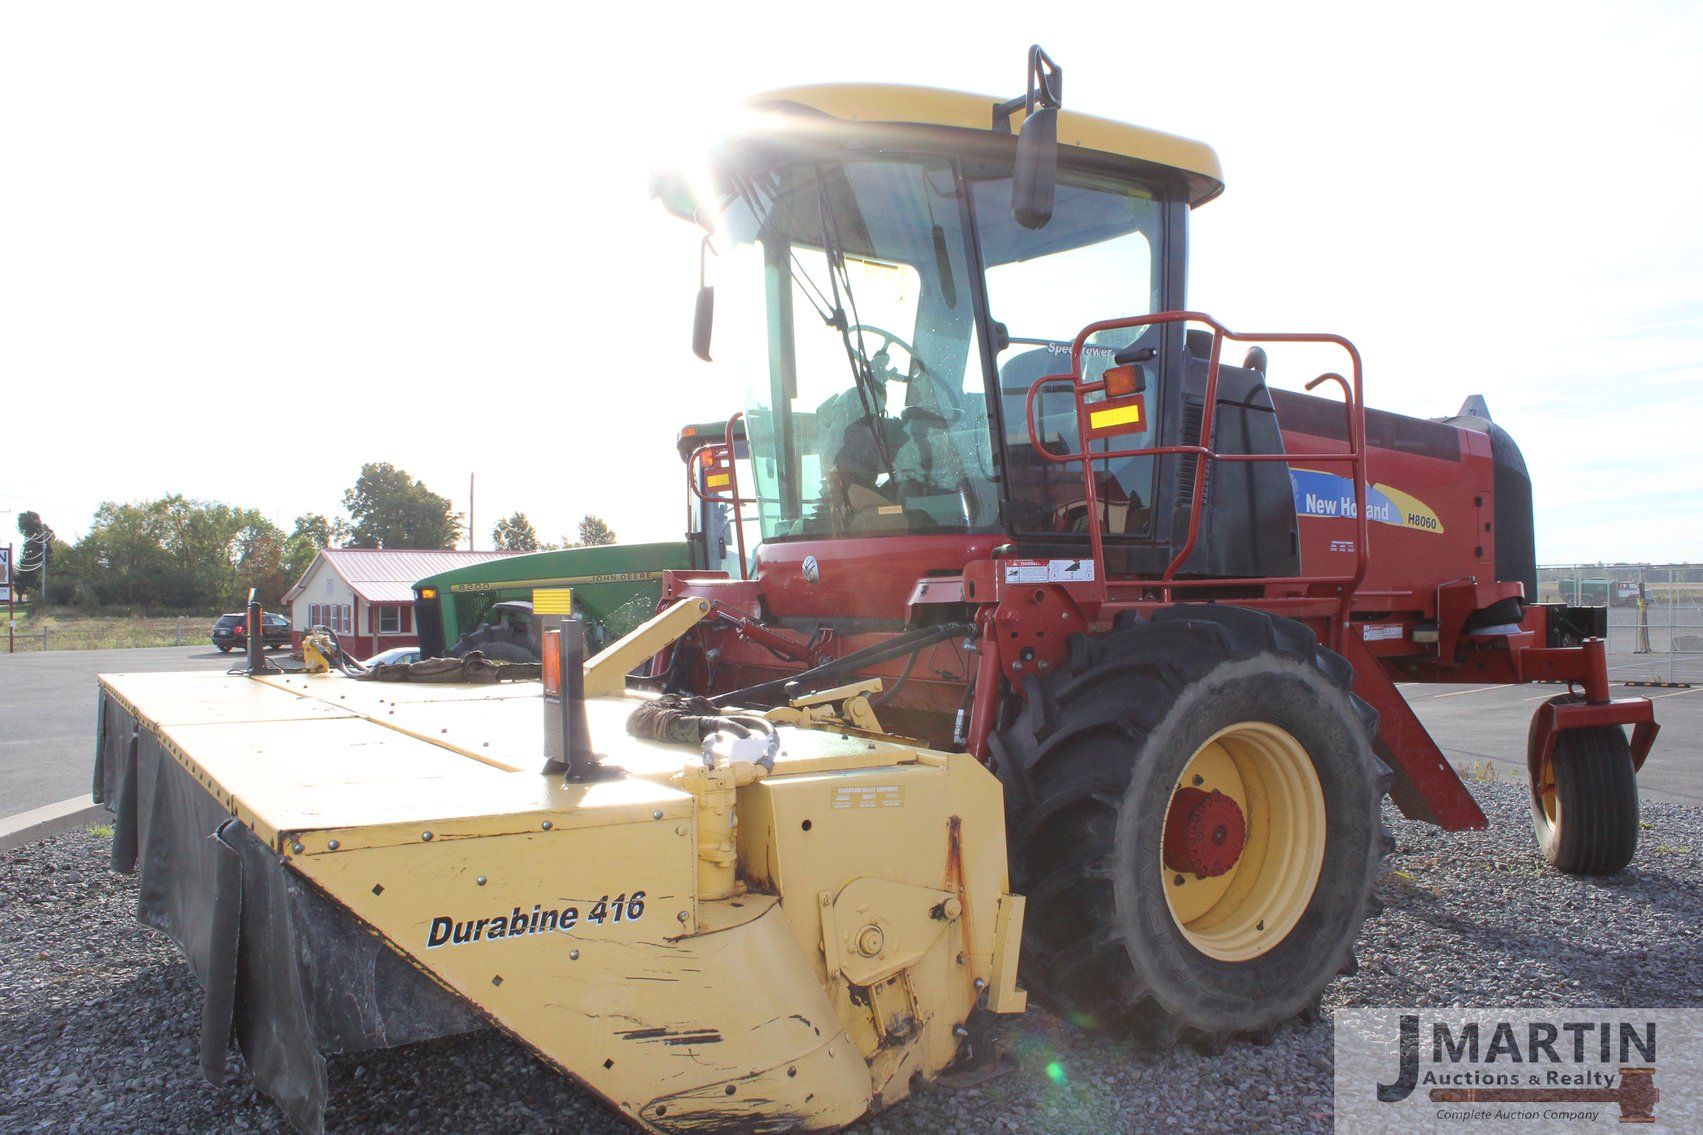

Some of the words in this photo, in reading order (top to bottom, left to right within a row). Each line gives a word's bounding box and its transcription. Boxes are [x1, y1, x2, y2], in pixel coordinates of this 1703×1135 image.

[1048, 342, 1112, 357] Speerower
[1306, 494, 1337, 514] New
[1341, 496, 1389, 520] Hoand
[1408, 513, 1437, 529] H8060
[590, 574, 617, 583] JOHN
[620, 572, 651, 582] DEERE
[459, 583, 490, 592] 8200
[428, 904, 579, 948] Durabine
[587, 891, 646, 925] 416
